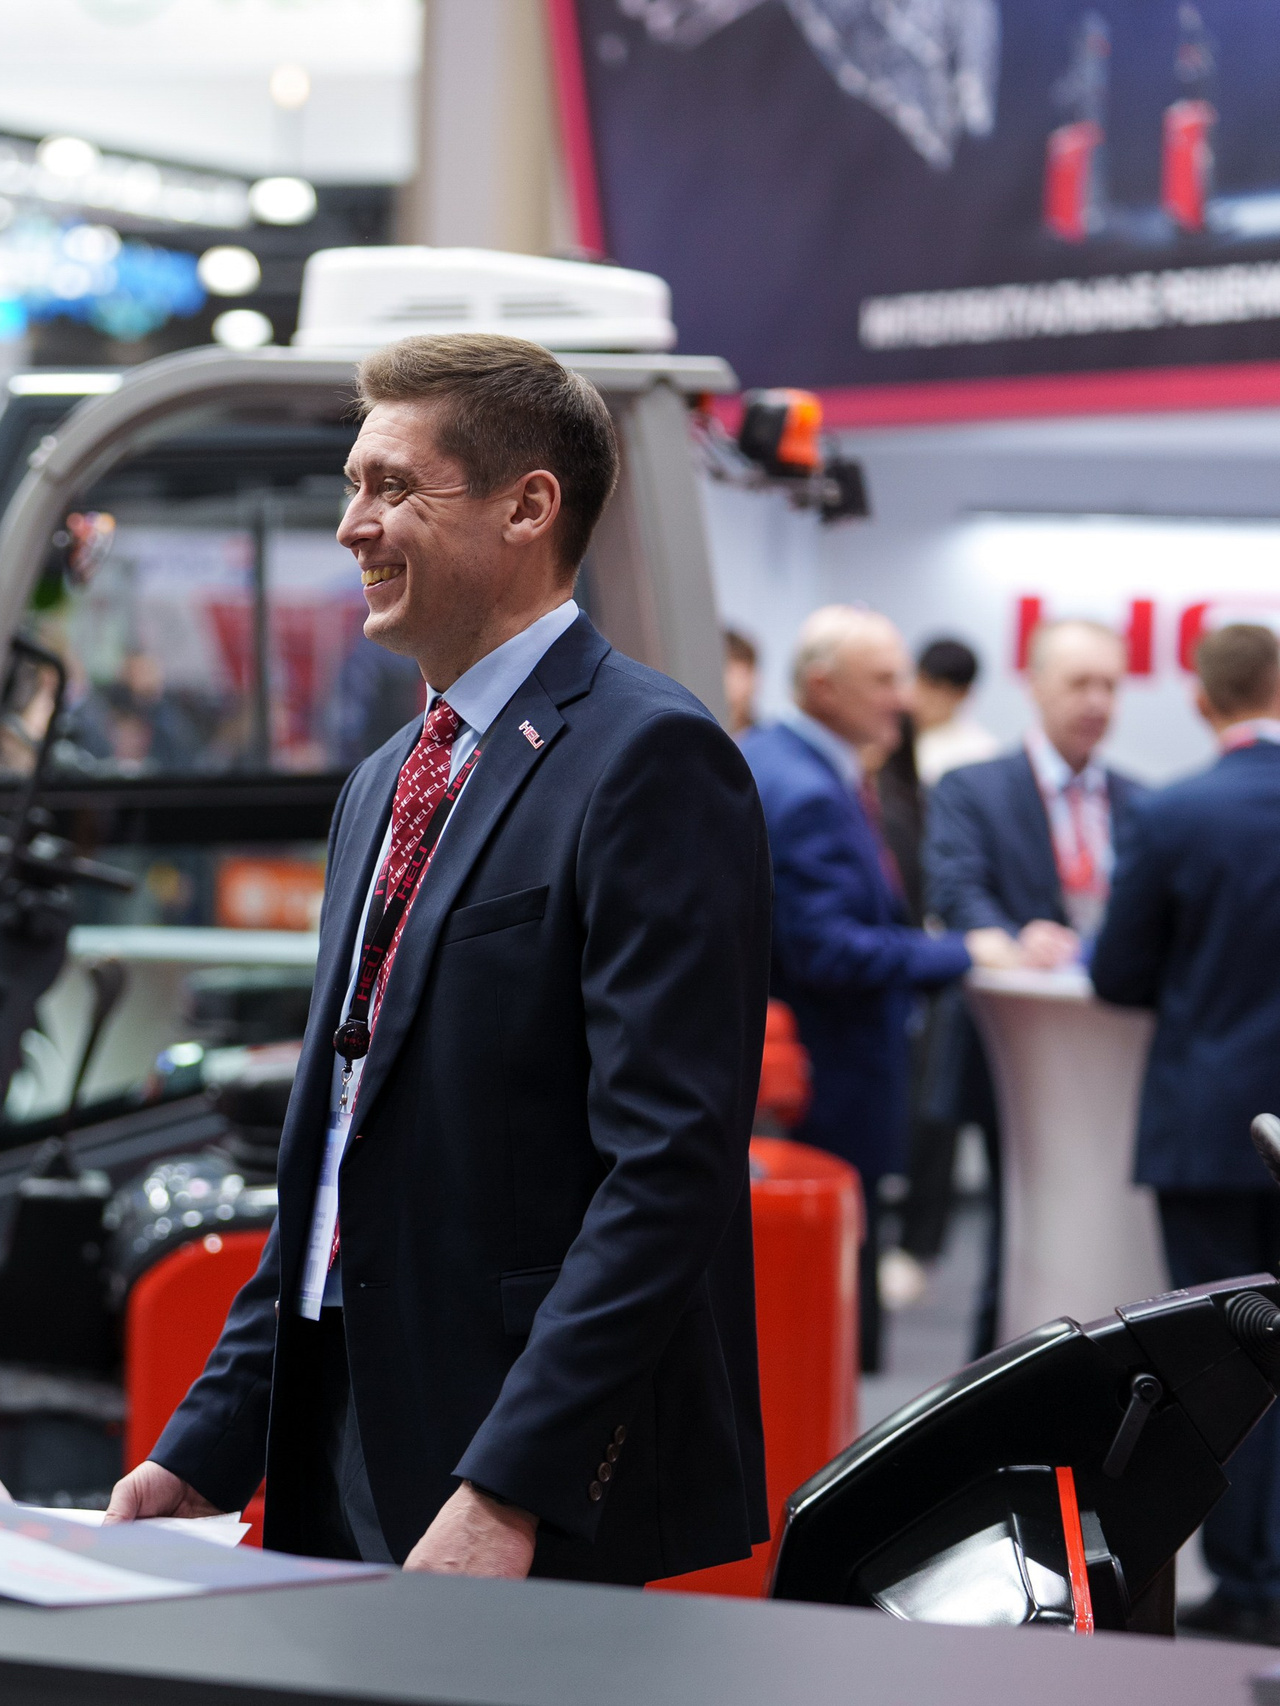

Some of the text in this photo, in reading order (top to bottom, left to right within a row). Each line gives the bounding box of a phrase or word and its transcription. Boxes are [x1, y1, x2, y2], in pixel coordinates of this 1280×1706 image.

[418, 742, 447, 760] HEL
[408, 758, 435, 786] HELI
[446, 749, 481, 801] HELI
[396, 785, 421, 814] HELI
[418, 777, 448, 803] HELI
[409, 802, 434, 831] HELI
[401, 829, 425, 857] HELI
[397, 845, 428, 900] HELI
[357, 945, 384, 1001] HELI
